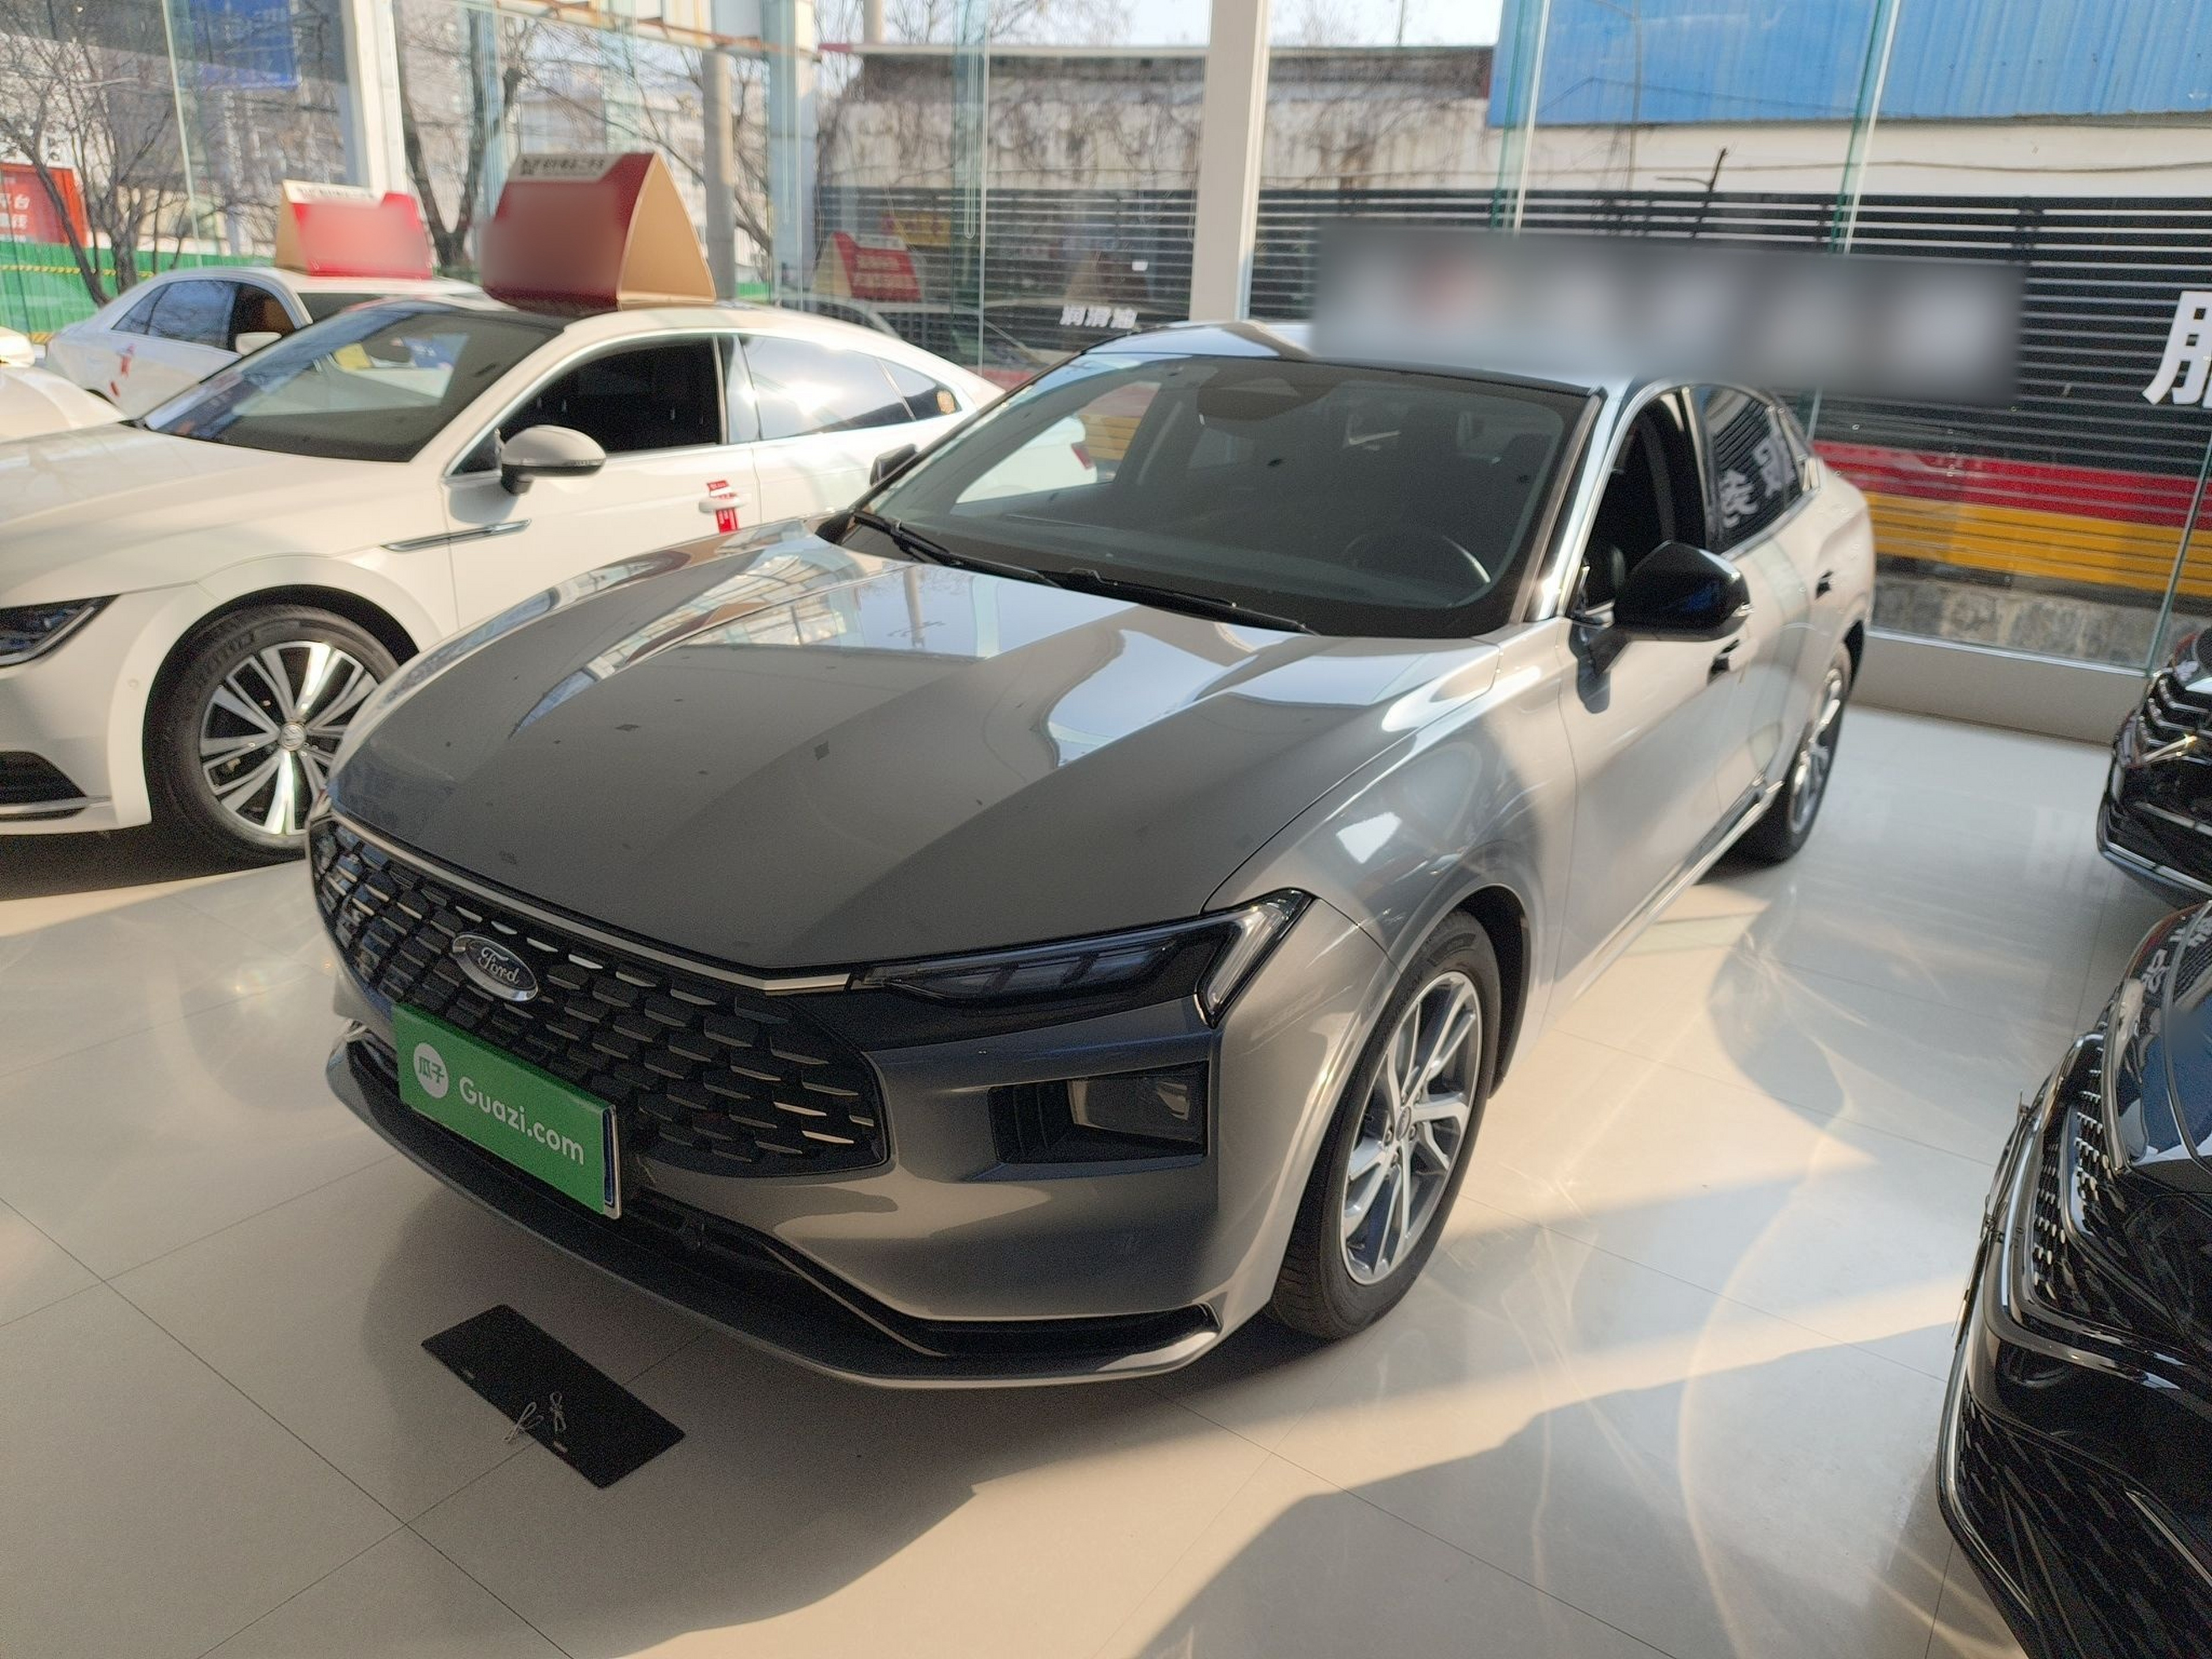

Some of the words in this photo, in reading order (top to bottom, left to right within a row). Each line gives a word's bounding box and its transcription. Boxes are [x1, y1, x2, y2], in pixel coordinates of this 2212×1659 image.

[478, 947, 518, 984] Ford
[419, 1057, 444, 1084] 瓜子
[460, 1077, 584, 1165] Guazi.com
